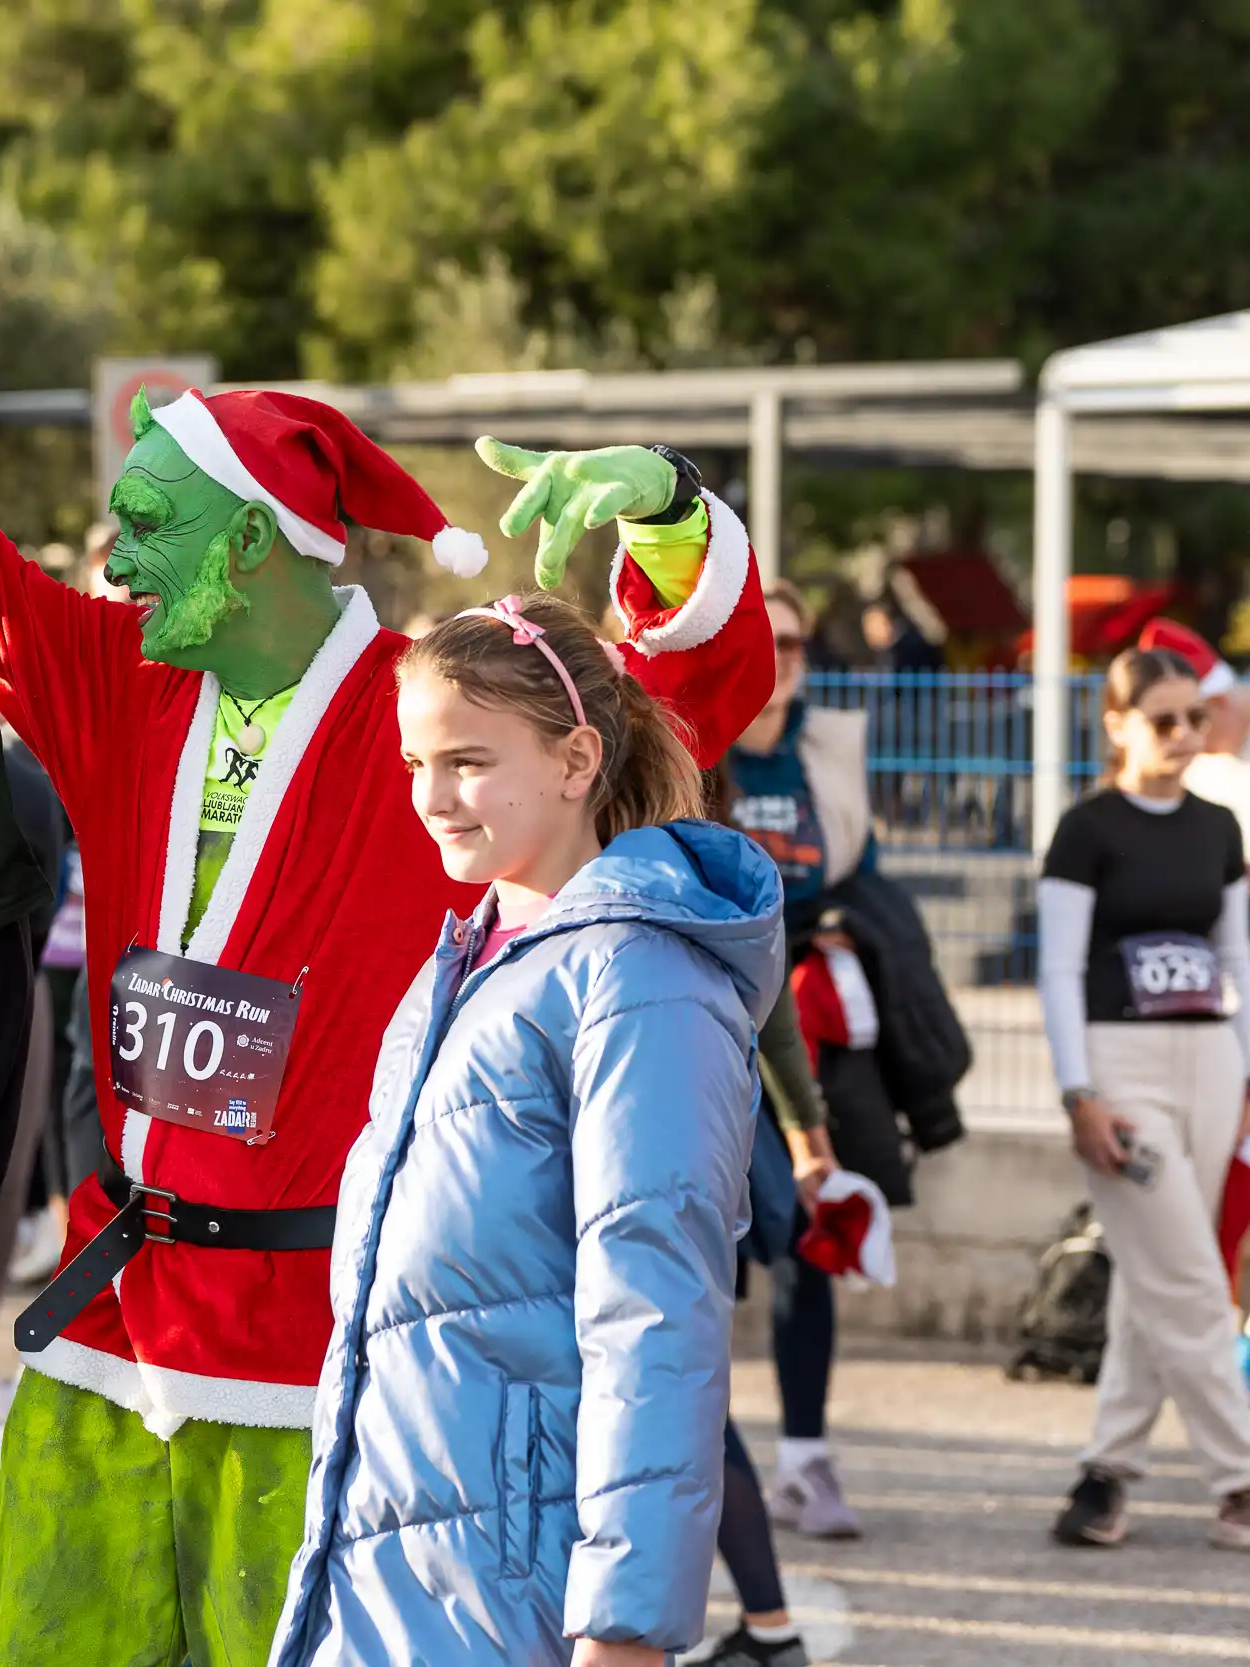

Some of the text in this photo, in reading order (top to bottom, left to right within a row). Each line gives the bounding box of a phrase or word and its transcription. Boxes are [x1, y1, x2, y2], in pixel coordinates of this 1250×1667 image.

[203, 798, 246, 814] LJUBLJAN
[128, 972, 271, 1025] ZADAR CHRISTMAS RUN
[119, 1001, 225, 1081] 310
